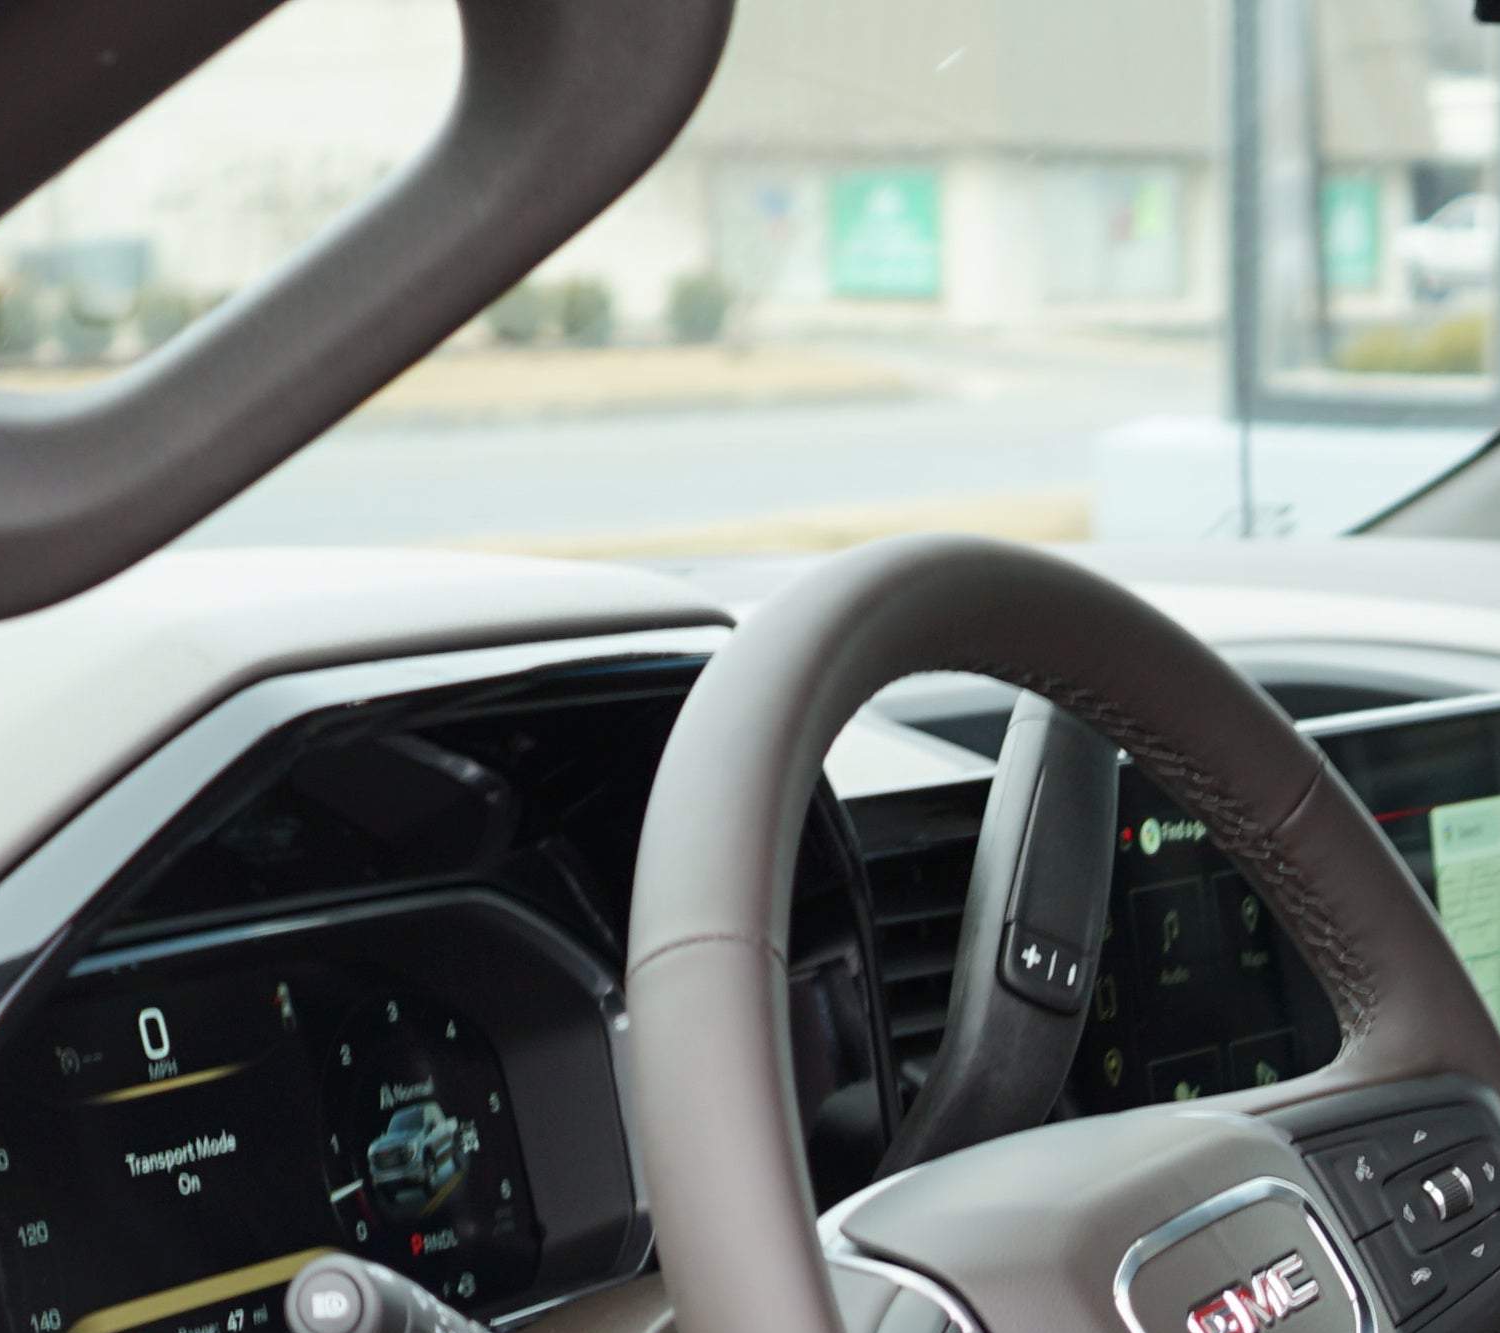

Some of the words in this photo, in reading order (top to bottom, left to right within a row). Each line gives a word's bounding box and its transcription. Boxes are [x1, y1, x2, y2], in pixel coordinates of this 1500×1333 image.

[386, 1000, 399, 1023] 3
[138, 1007, 170, 1061] 0
[340, 1043, 352, 1066] 2
[148, 1057, 178, 1081] MPH
[125, 1142, 195, 1177] Transport
[195, 1129, 237, 1158] Mode
[178, 1172, 201, 1195] On
[17, 1220, 49, 1248] 120
[227, 1308, 245, 1333] 47
